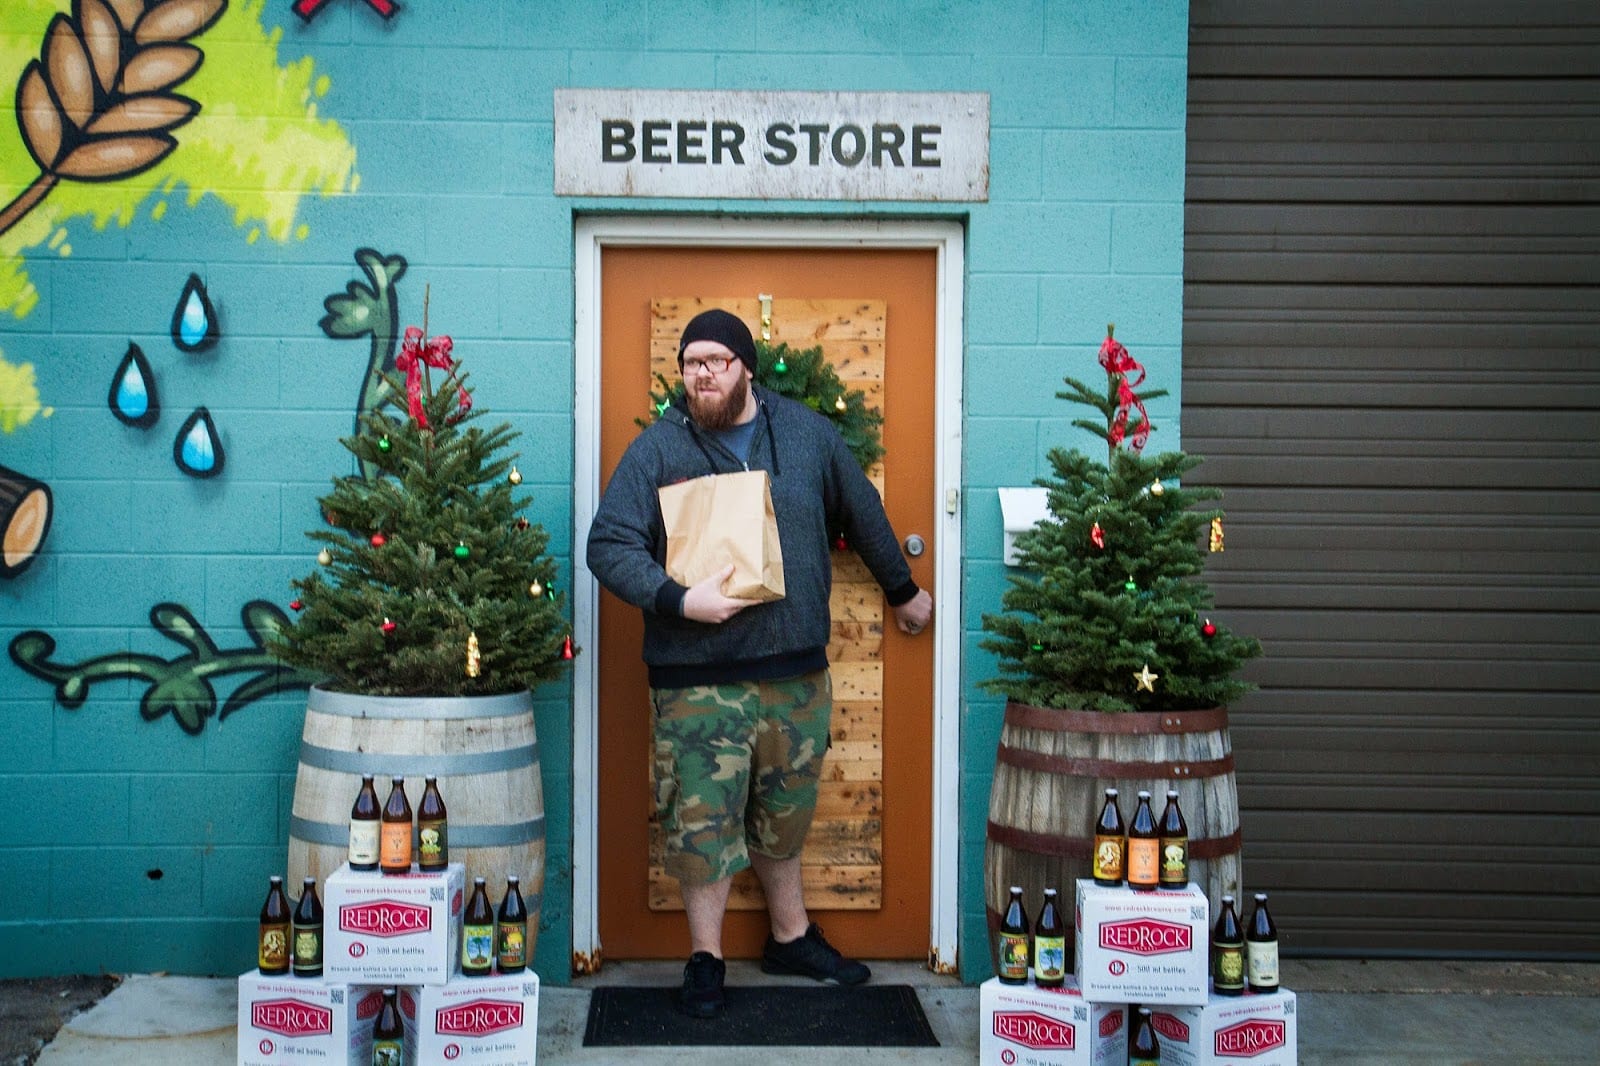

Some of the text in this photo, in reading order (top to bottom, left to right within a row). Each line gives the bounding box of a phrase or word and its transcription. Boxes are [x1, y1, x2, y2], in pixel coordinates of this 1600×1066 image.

[602, 119, 942, 168] BEER STORE
[345, 907, 426, 929] REDROCK
[1106, 926, 1185, 948] REDROCK
[257, 1006, 326, 1030] REDROCK
[442, 1006, 517, 1030] REDROCK
[998, 1015, 1069, 1045] REDROCK
[1219, 1025, 1281, 1051] REDROCK
